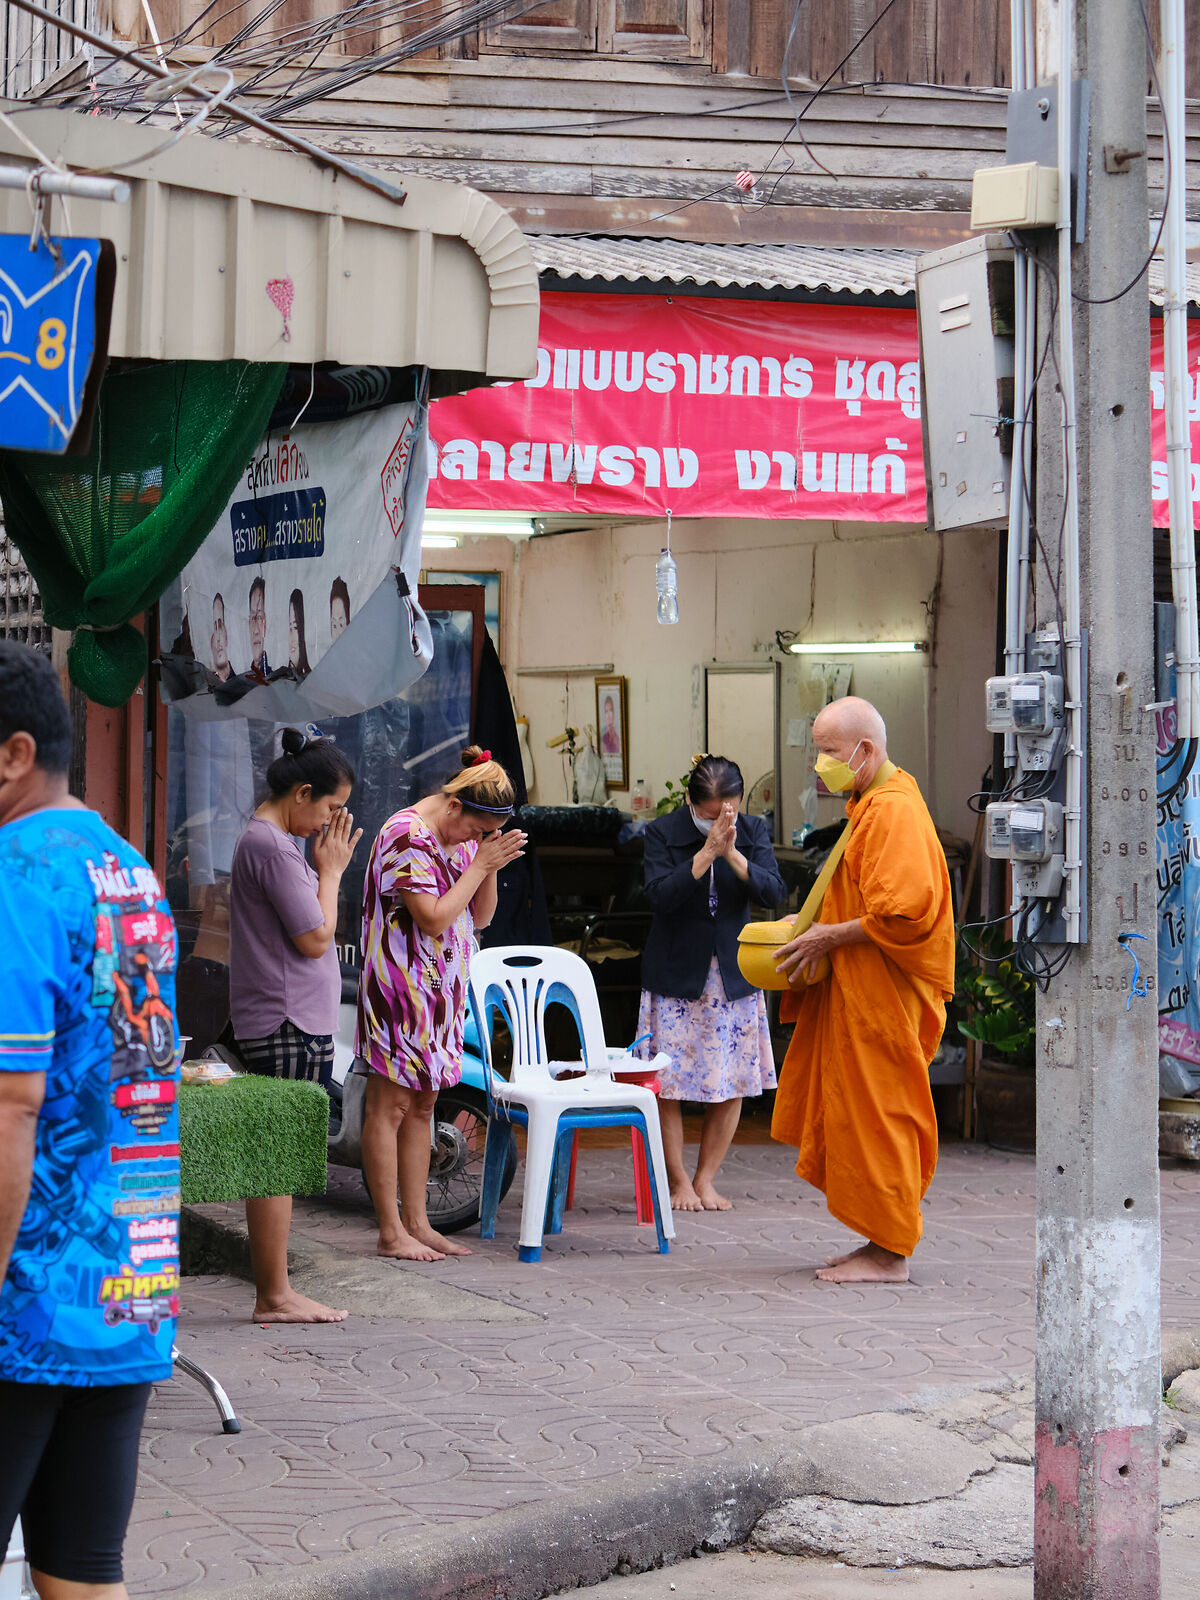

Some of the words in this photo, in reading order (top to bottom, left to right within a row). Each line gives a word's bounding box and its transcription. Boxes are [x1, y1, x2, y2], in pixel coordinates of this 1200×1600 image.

[35, 316, 68, 371] 8
[491, 346, 813, 400] งแบบราชการ
[834, 359, 923, 419] ชุดสู
[735, 438, 907, 494] งานแก้
